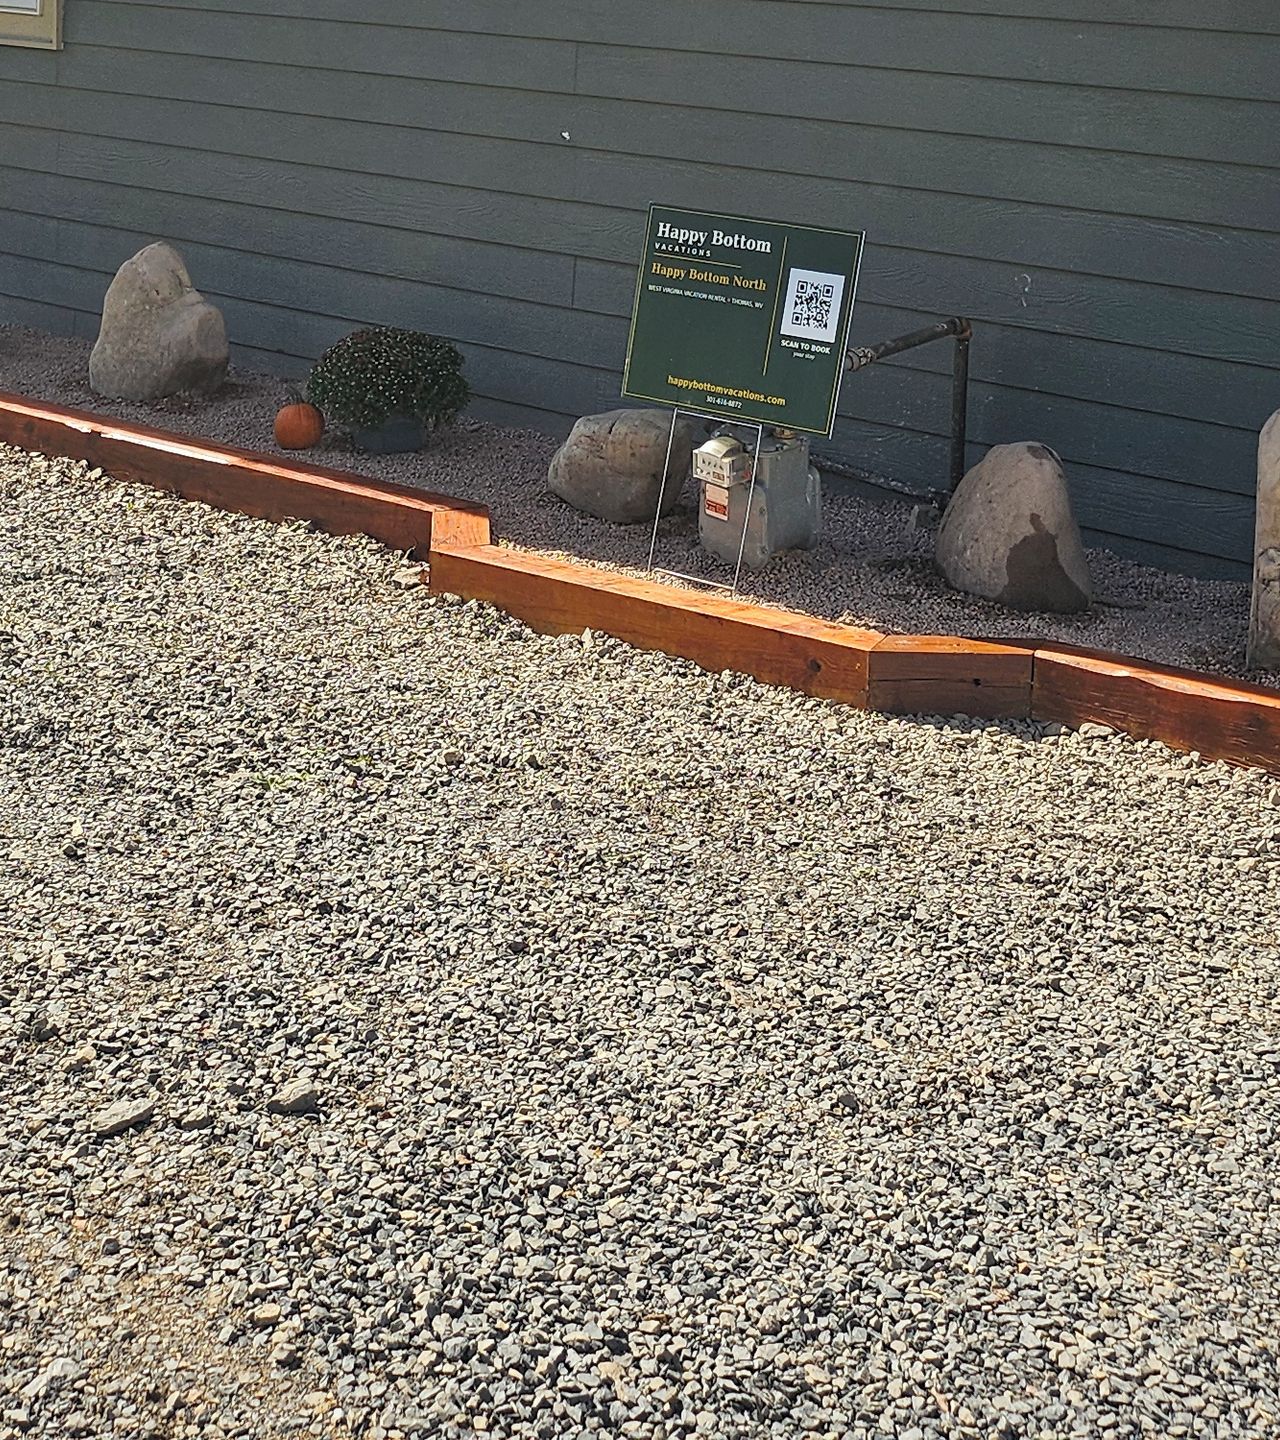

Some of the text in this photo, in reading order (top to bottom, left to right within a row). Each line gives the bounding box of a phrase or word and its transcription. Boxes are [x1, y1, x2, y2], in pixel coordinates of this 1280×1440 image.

[654, 242, 712, 258] VACATIONS
[657, 222, 772, 254] Happy Bottom
[651, 262, 767, 291] Happy Bottom North
[648, 284, 662, 293] WEST
[662, 286, 684, 297] VIRGINIA
[684, 289, 708, 300] VACATION
[708, 294, 726, 304] RENTAL
[754, 302, 764, 310] WV
[780, 339, 831, 355] SCAN TO BOOK
[667, 374, 786, 407] happybottomvacations.com
